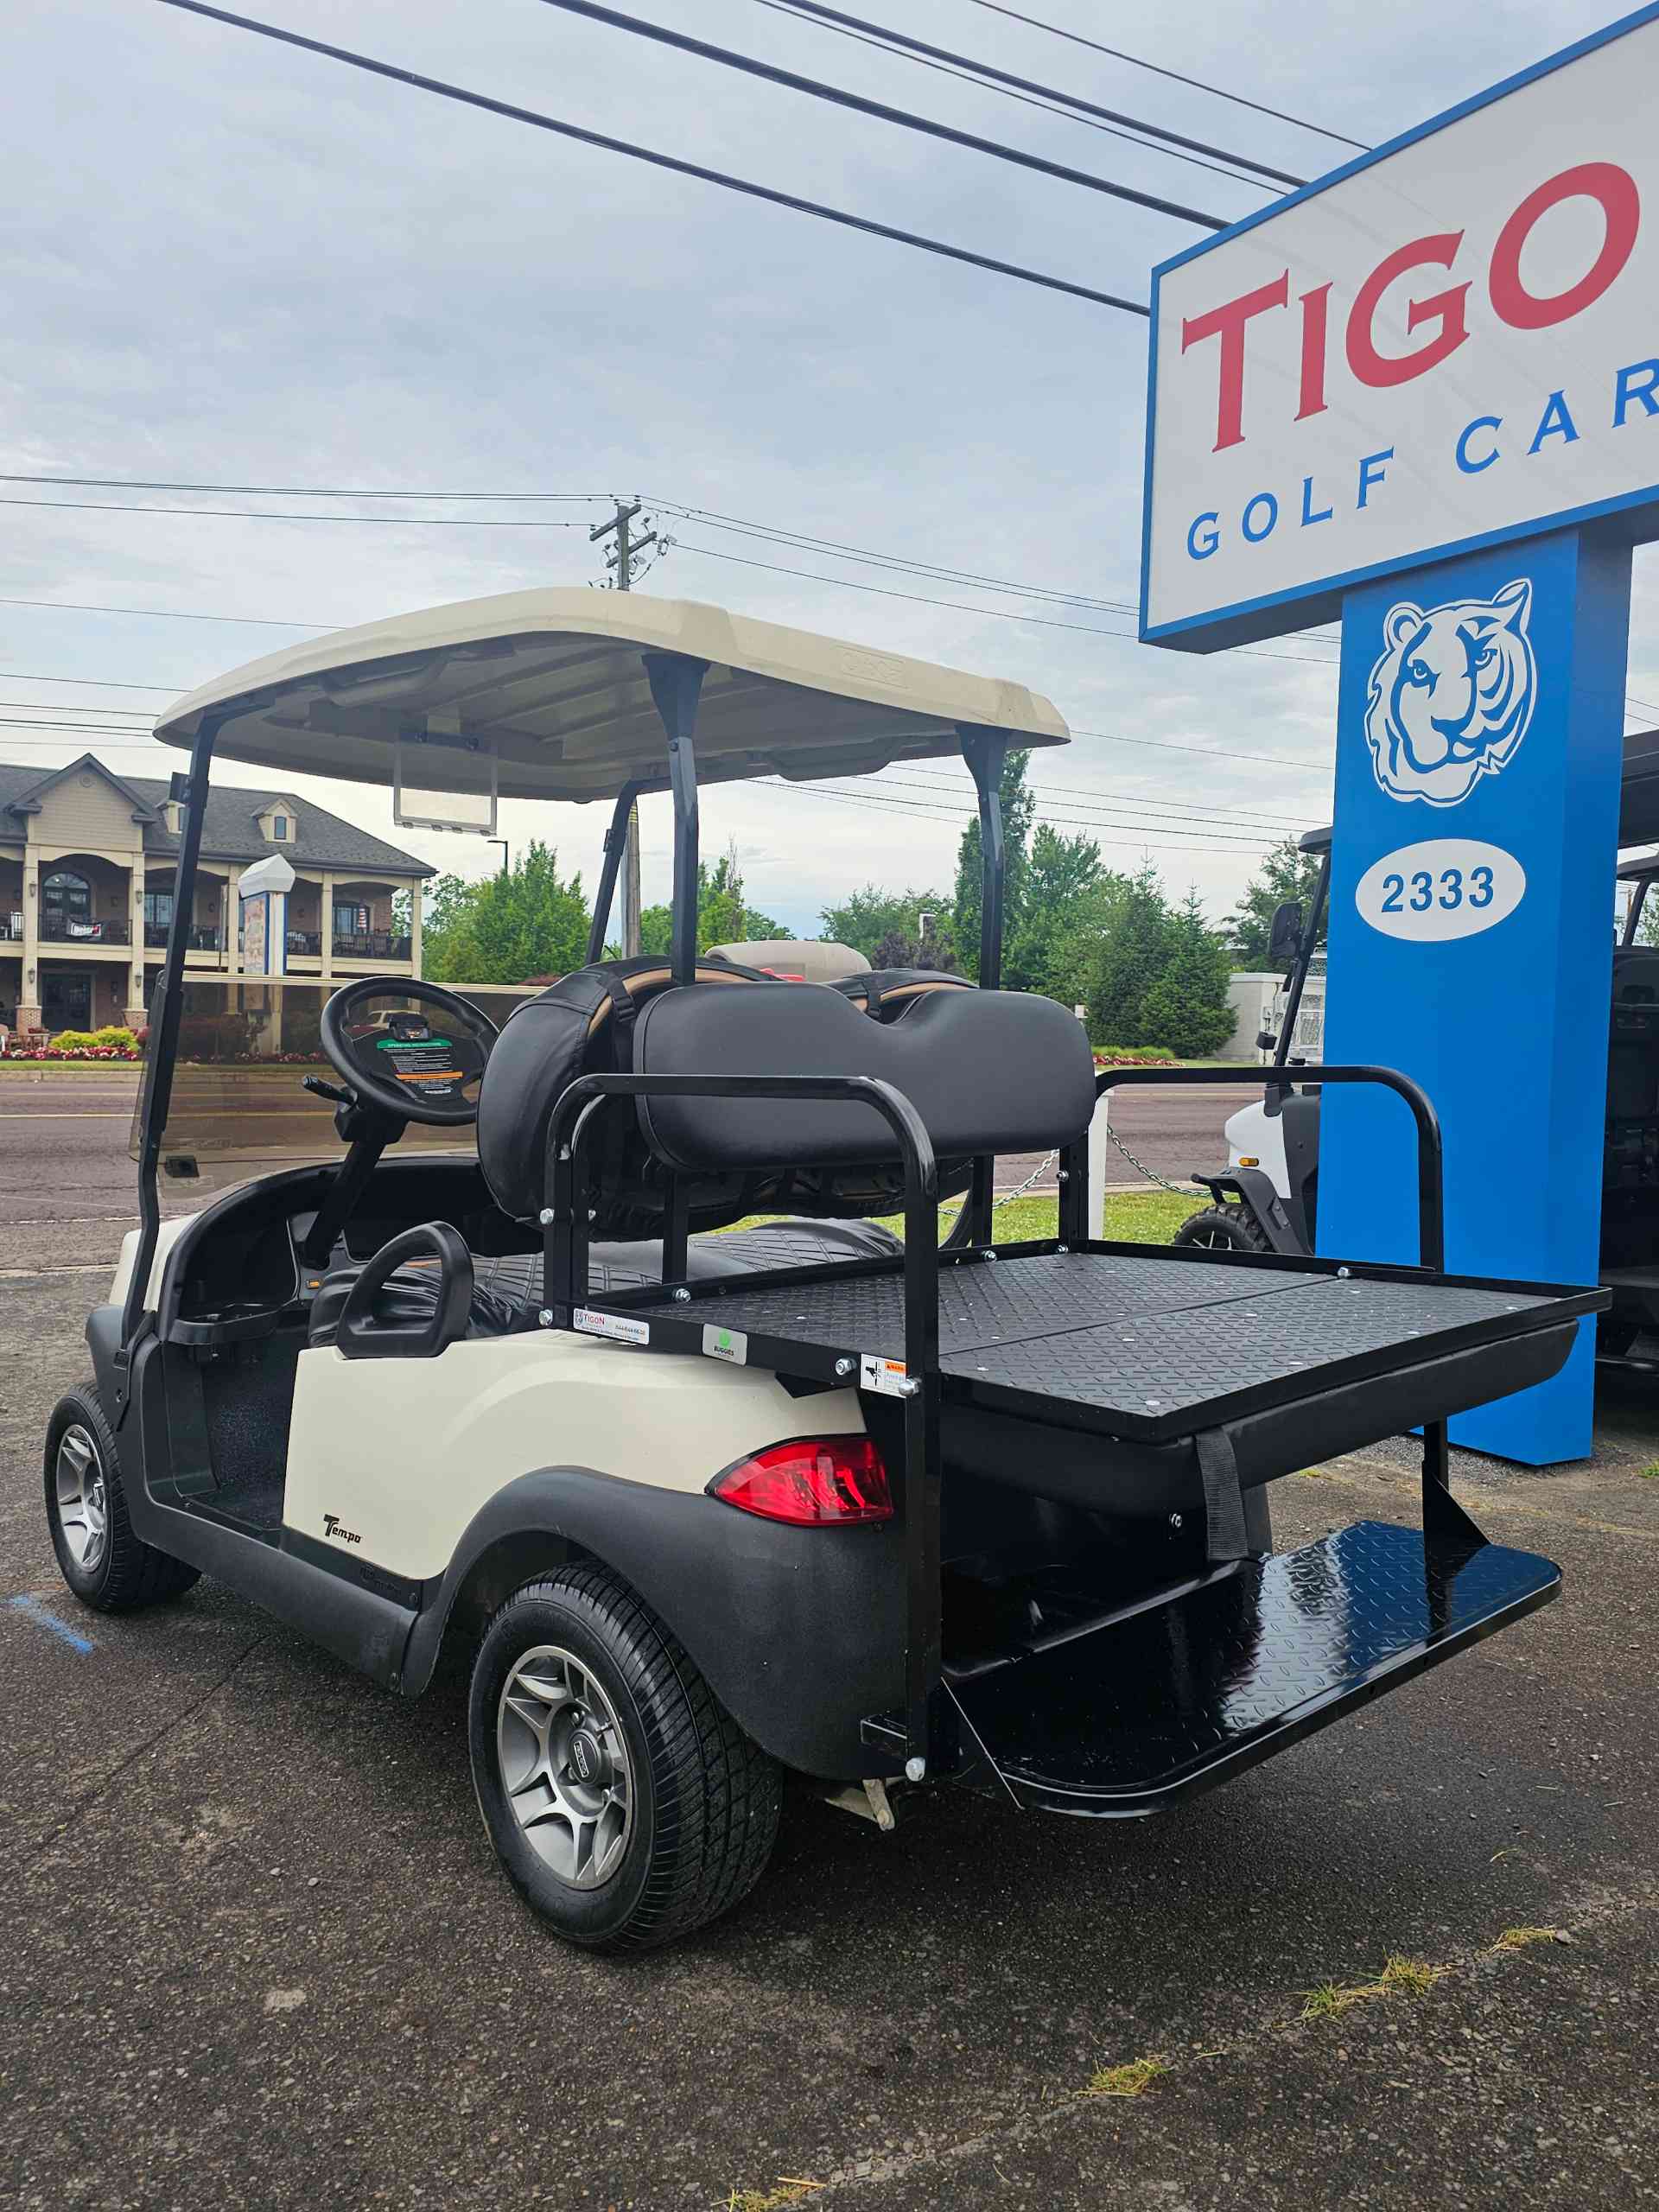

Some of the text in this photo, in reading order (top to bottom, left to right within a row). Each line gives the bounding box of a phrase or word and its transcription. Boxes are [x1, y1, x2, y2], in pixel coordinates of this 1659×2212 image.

[1182, 162, 1640, 454] TIGO
[1186, 358, 1659, 561] GOLF CAR
[1381, 866, 1495, 913] 2333
[323, 1514, 361, 1543] Tempo
